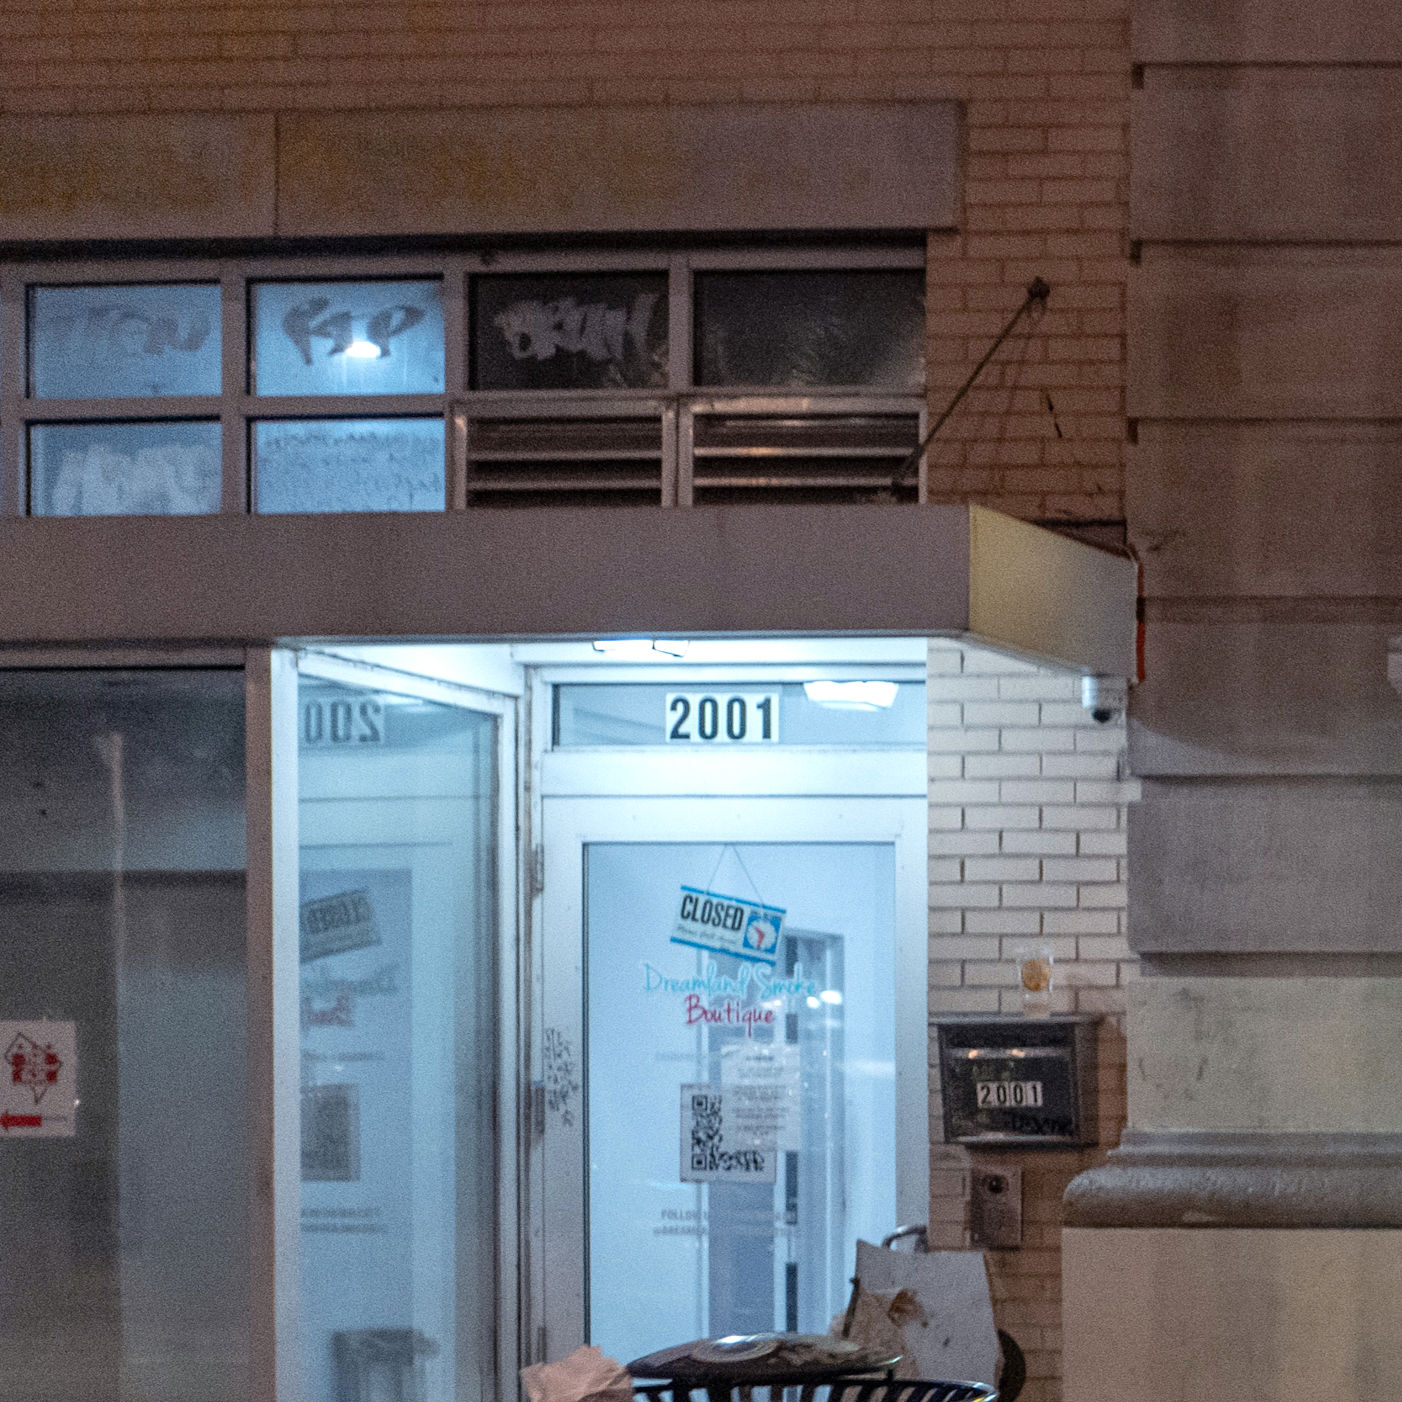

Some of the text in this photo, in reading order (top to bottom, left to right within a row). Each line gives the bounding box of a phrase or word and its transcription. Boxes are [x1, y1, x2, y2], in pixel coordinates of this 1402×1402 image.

[669, 696, 775, 742] 2001
[681, 893, 744, 931] CLOSED
[684, 993, 775, 1038] Boutique
[980, 1085, 1038, 1104] 2001
